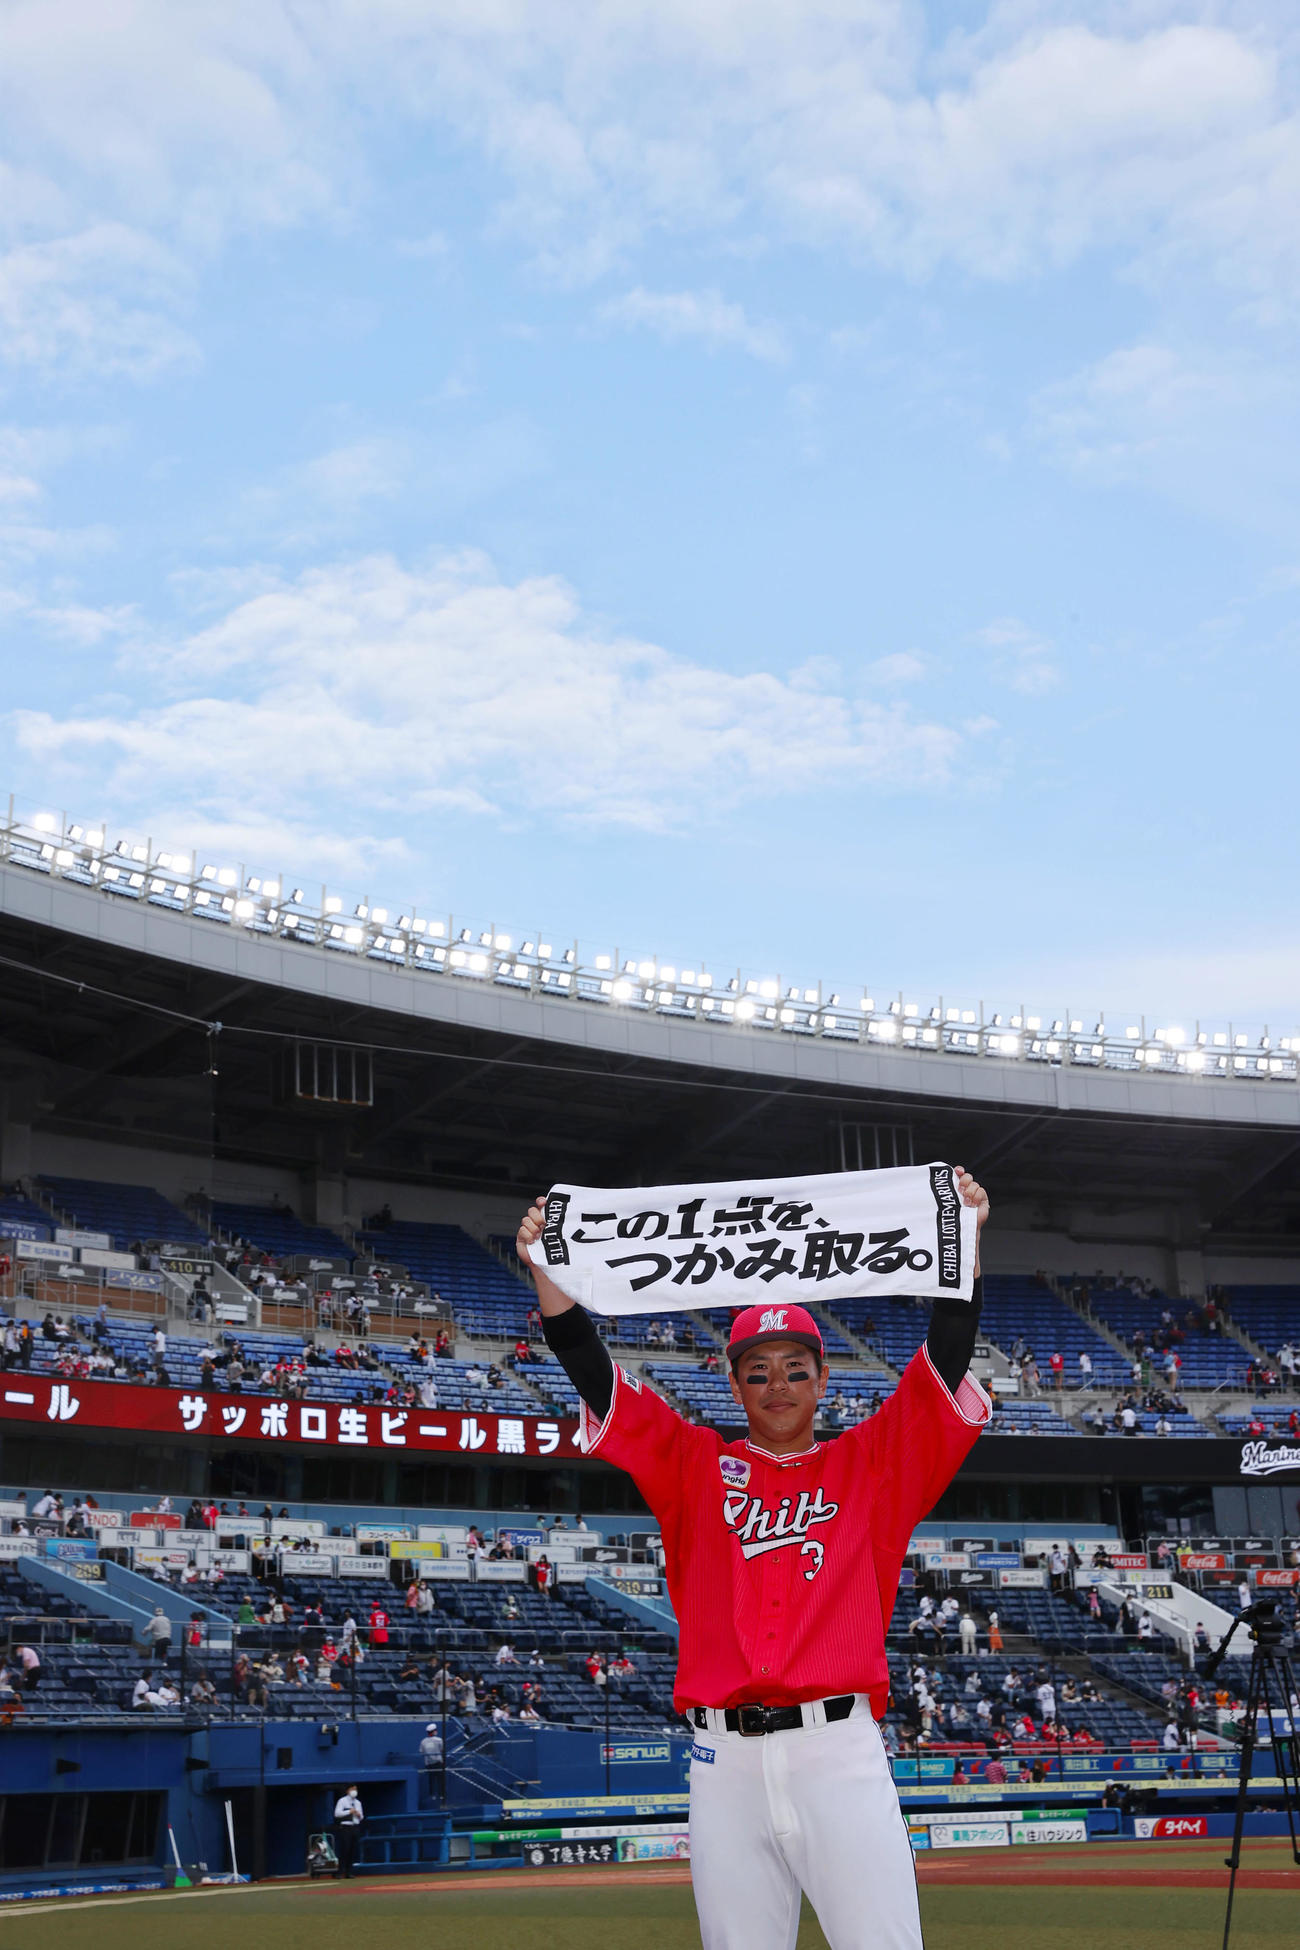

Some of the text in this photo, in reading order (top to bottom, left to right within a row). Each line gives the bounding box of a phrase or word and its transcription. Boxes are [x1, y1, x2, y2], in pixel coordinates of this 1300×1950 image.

[571, 1196, 831, 1244] この1点を、
[605, 1228, 933, 1291] つかみ取る。
[942, 1244, 957, 1281] CHIBA
[757, 1308, 788, 1333] M
[801, 1540, 824, 1581] 3
[1147, 1586, 1169, 1597] 211
[615, 1747, 669, 1759] SANWA
[1164, 1819, 1202, 1835] タイヘイ
